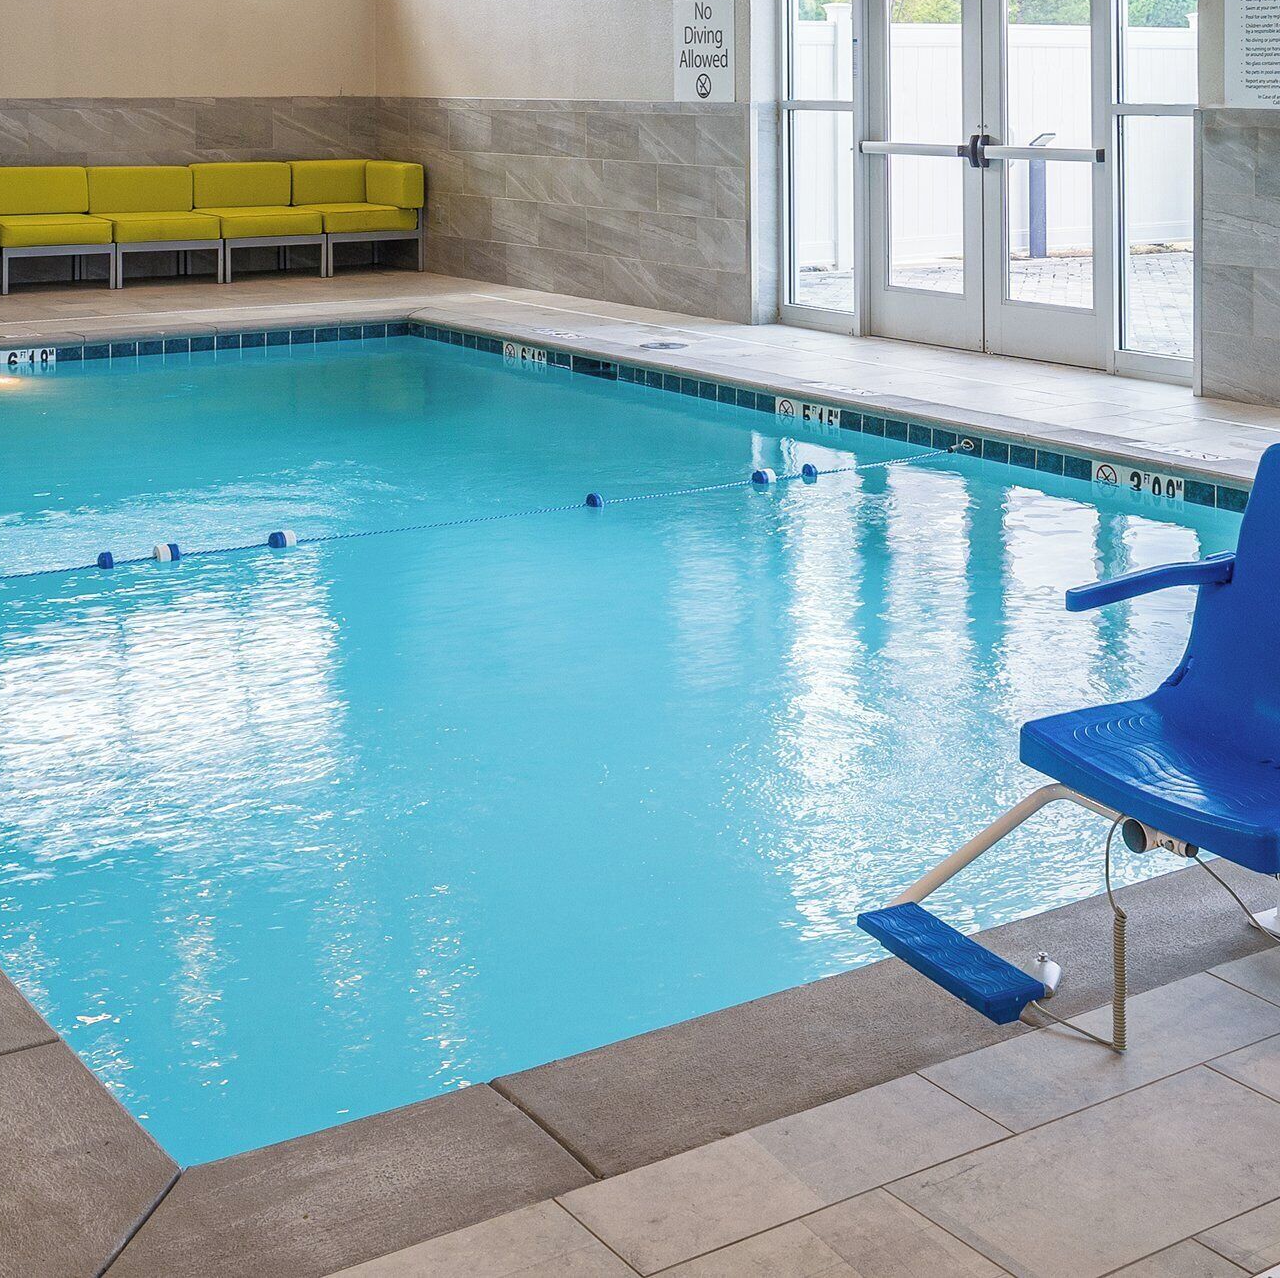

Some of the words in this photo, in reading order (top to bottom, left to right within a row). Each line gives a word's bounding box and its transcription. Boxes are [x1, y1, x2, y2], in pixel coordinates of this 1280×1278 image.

[694, 2, 712, 20] No
[684, 26, 723, 49] Diving
[679, 48, 728, 68] Allowed
